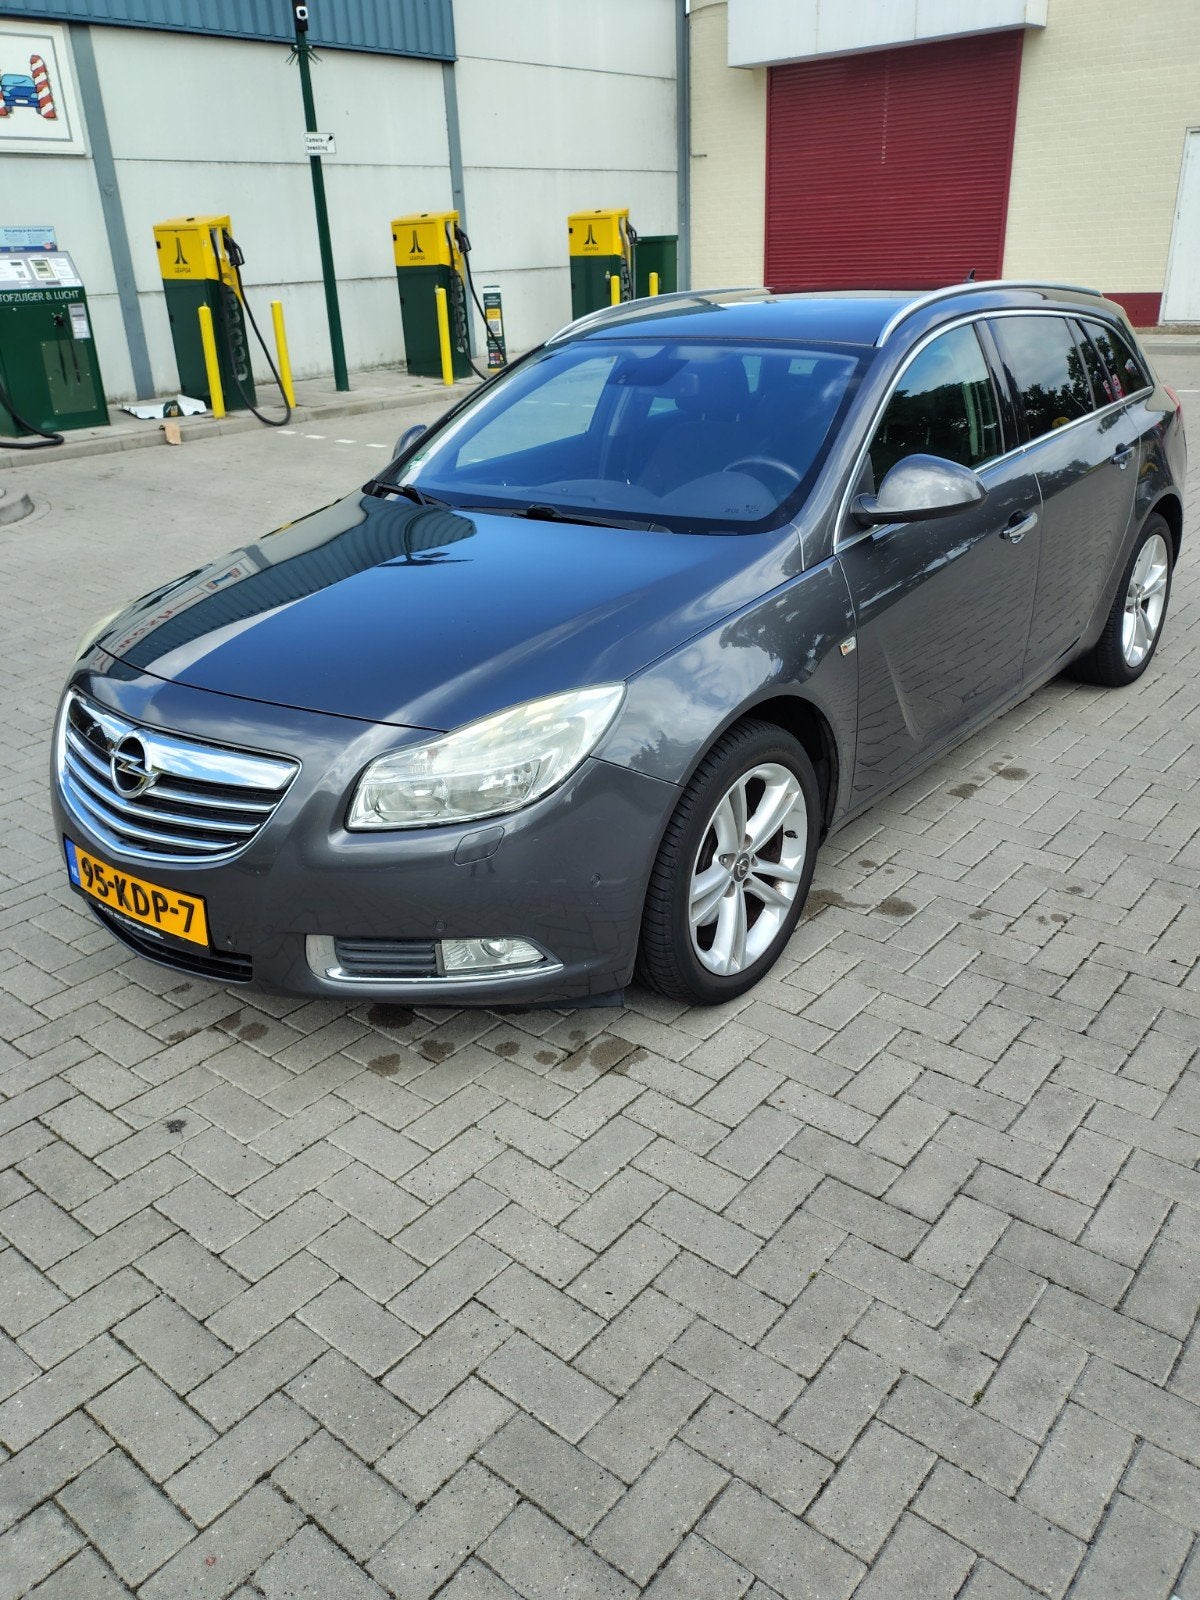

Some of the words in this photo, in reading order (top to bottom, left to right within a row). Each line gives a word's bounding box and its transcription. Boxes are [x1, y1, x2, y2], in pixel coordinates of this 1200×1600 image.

[45, 292, 53, 300] &
[54, 290, 79, 300] LUCHT
[81, 857, 195, 933] 95-KDP-7
